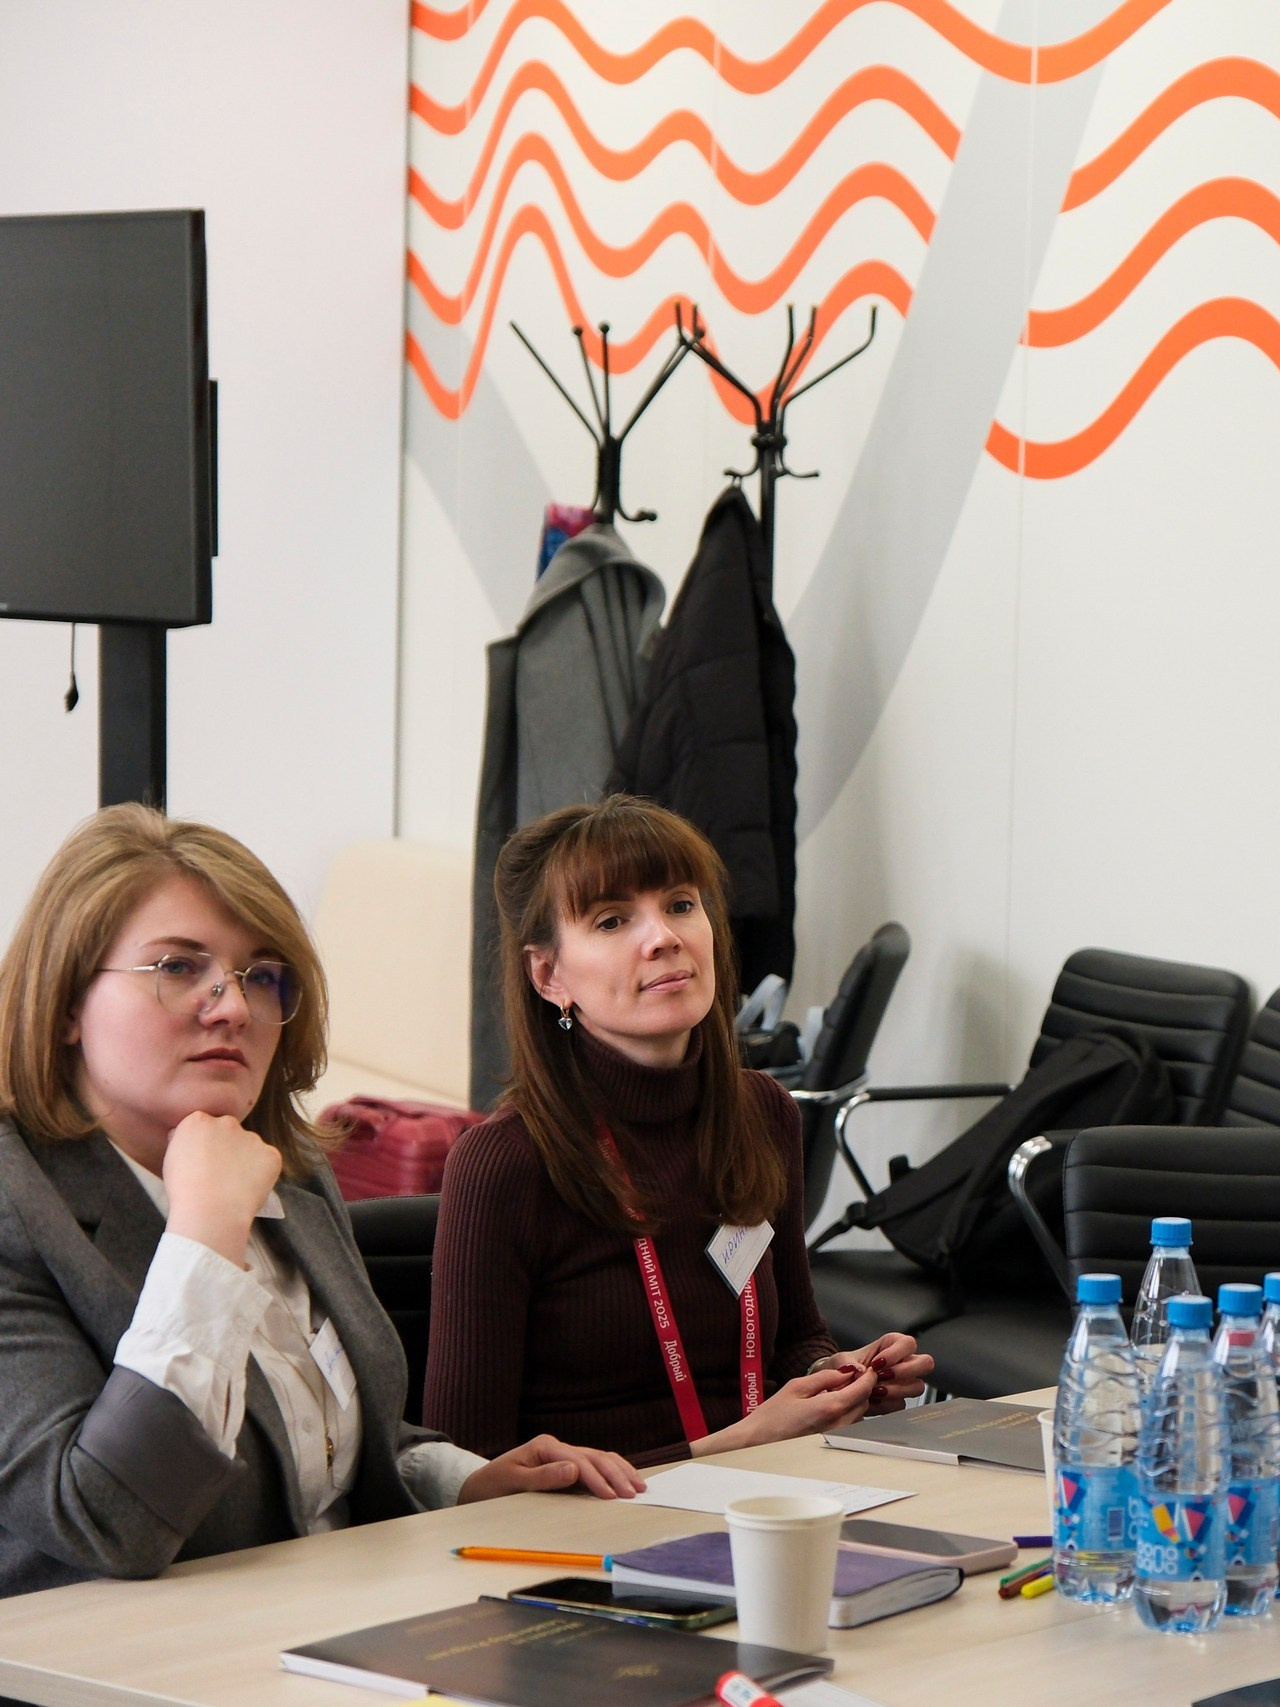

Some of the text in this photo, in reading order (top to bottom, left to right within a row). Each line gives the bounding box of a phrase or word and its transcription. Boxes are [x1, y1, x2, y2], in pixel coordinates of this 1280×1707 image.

[653, 1300, 670, 1329] 2025
[663, 1340, 688, 1383] Добрый
[745, 1274, 756, 1358] НОВОГОДНИ
